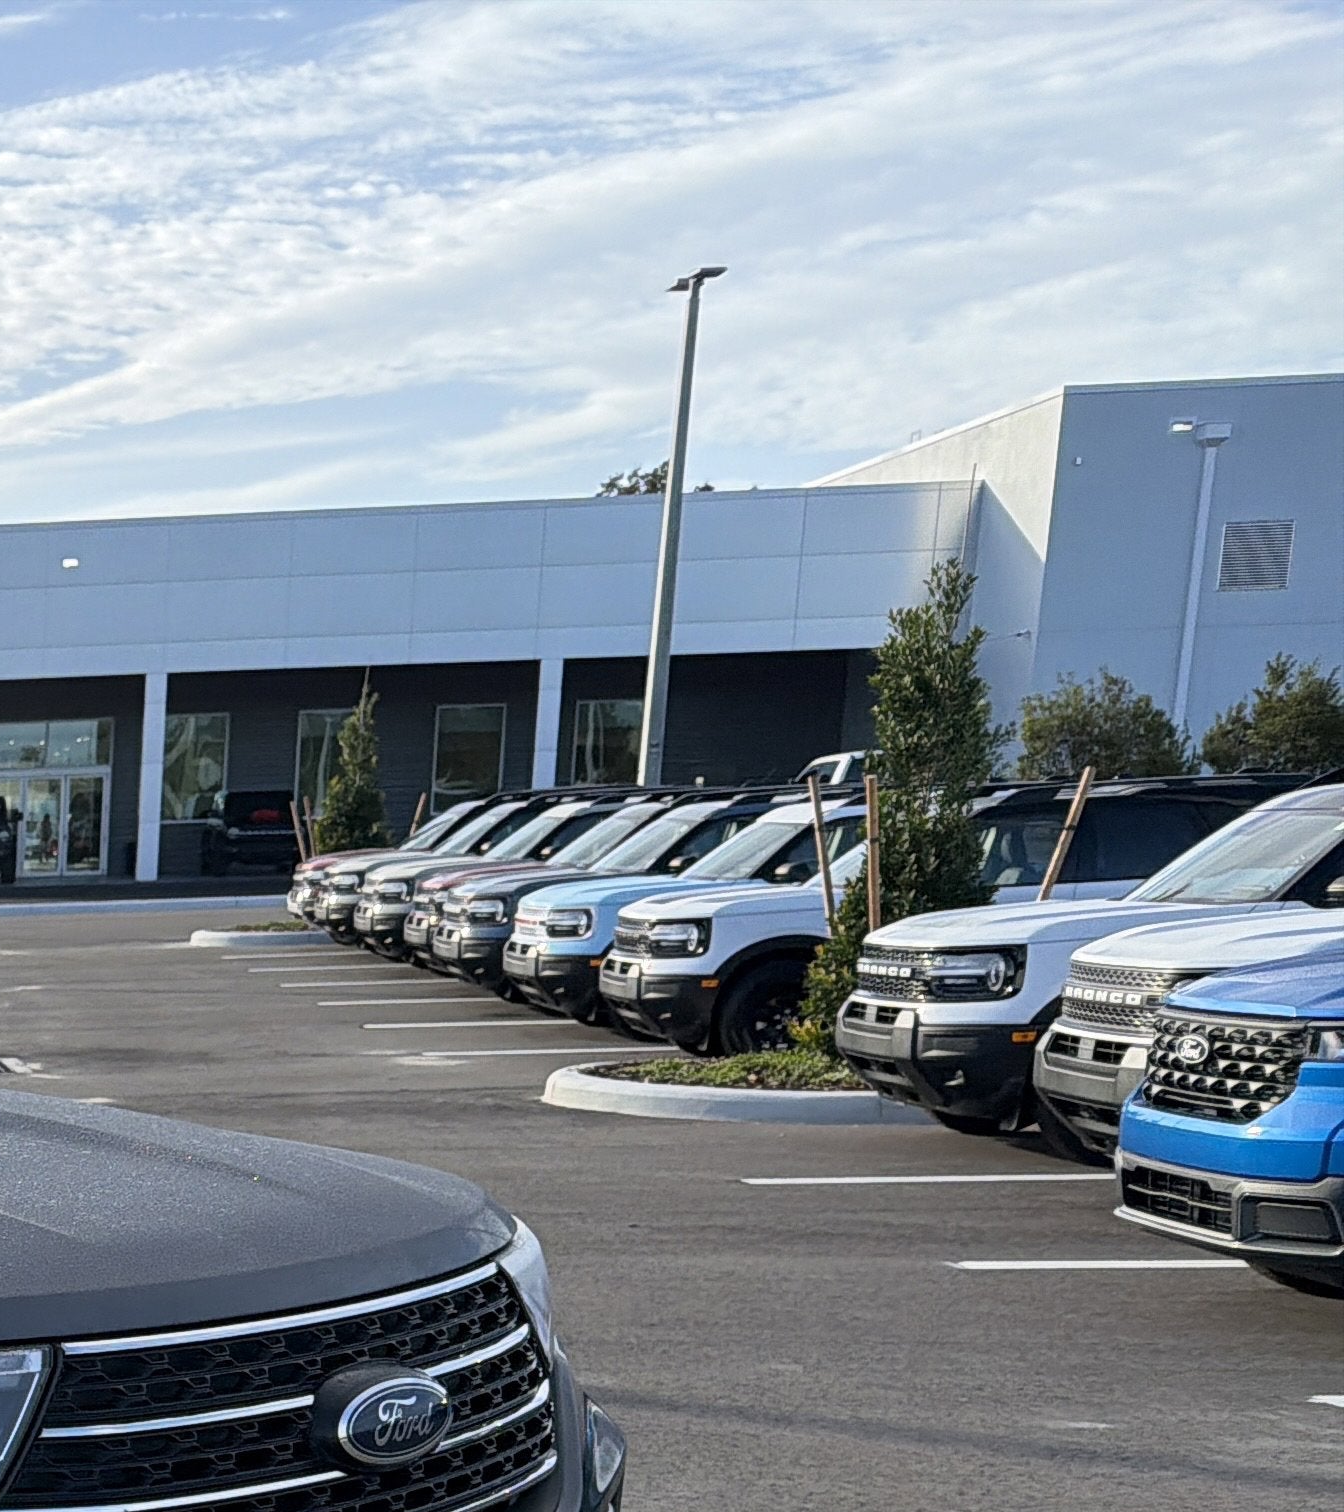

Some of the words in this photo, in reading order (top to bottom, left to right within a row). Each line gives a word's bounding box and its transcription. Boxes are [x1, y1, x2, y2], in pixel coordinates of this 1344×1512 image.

[856, 963, 912, 978] BRONCO
[1065, 986, 1142, 1006] BRONCO
[1181, 1039, 1203, 1060] Ford
[375, 1396, 433, 1446] Ford
